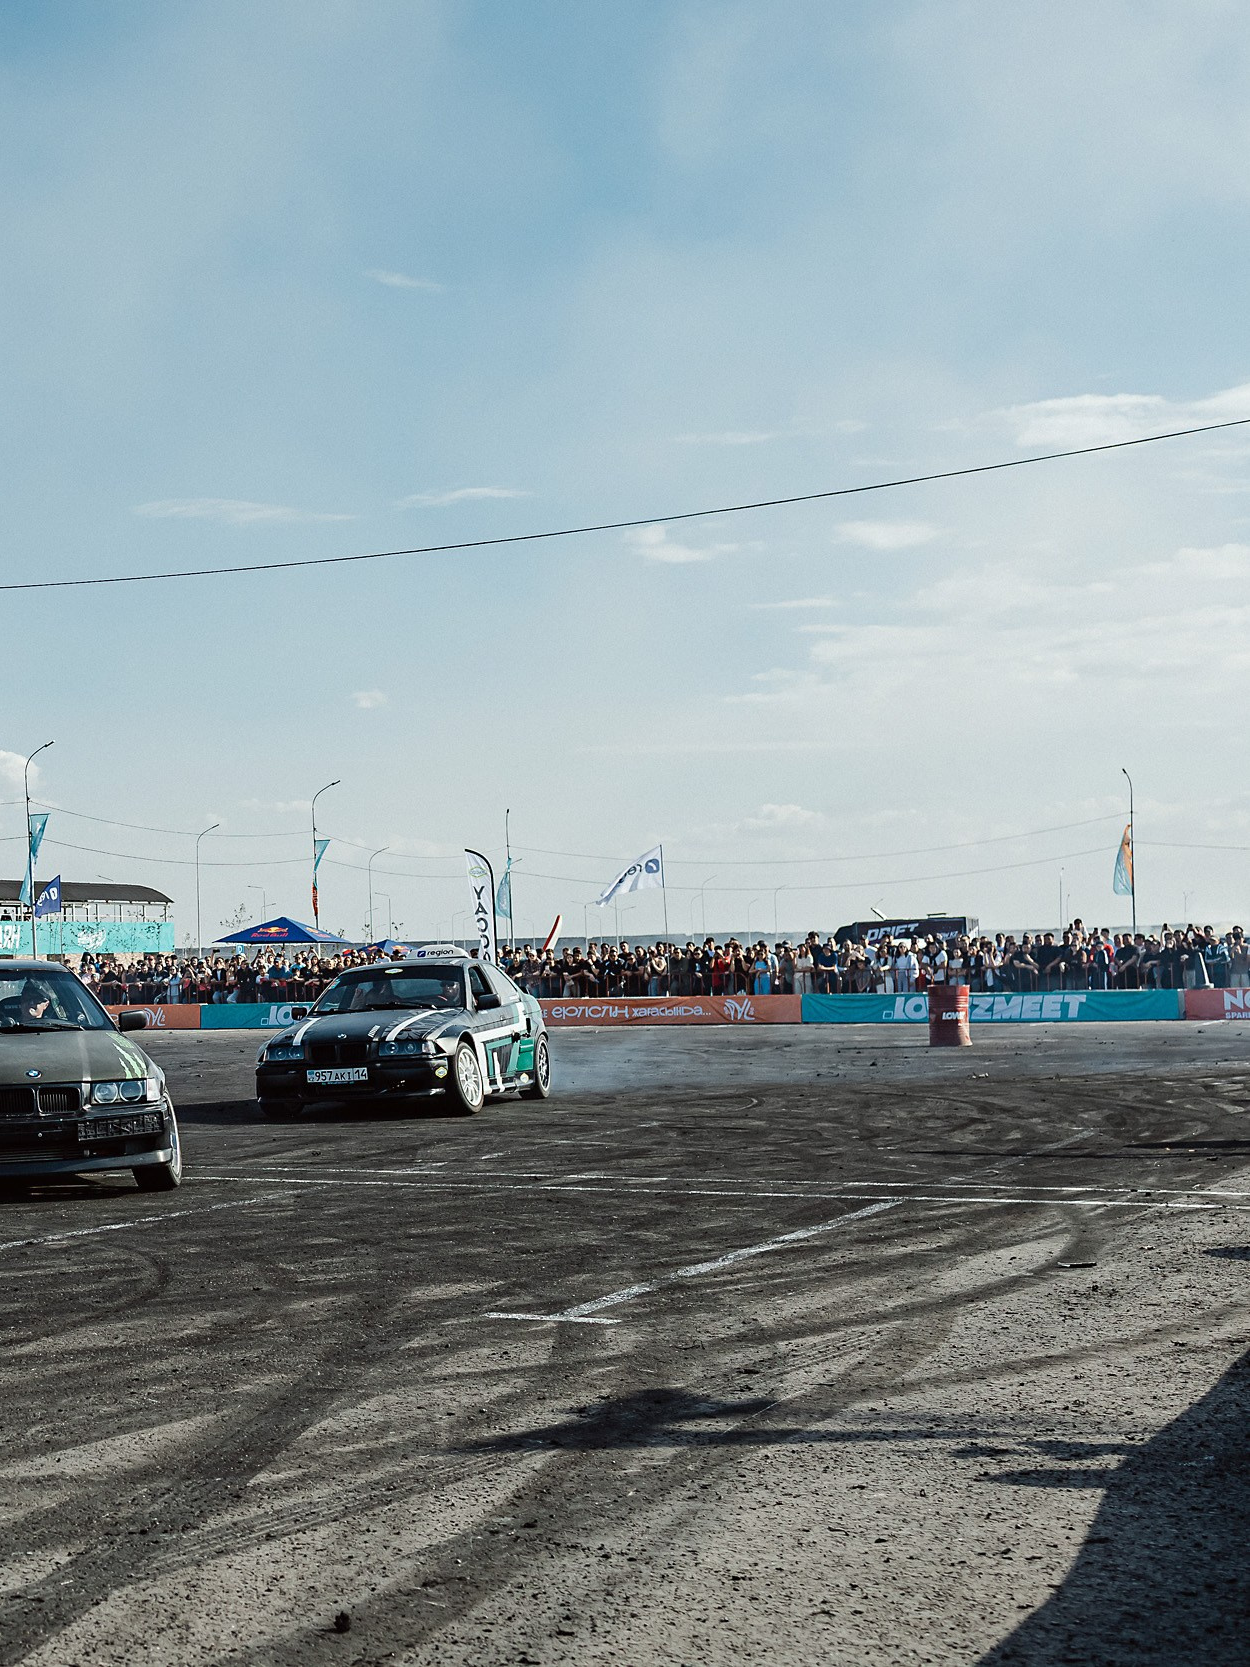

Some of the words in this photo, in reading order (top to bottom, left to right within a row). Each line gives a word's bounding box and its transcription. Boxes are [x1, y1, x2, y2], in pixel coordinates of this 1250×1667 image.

[427, 949, 453, 957] region
[894, 995, 1086, 1020] LOZMEET
[315, 1070, 333, 1081] 957
[354, 1069, 367, 1079] 14
